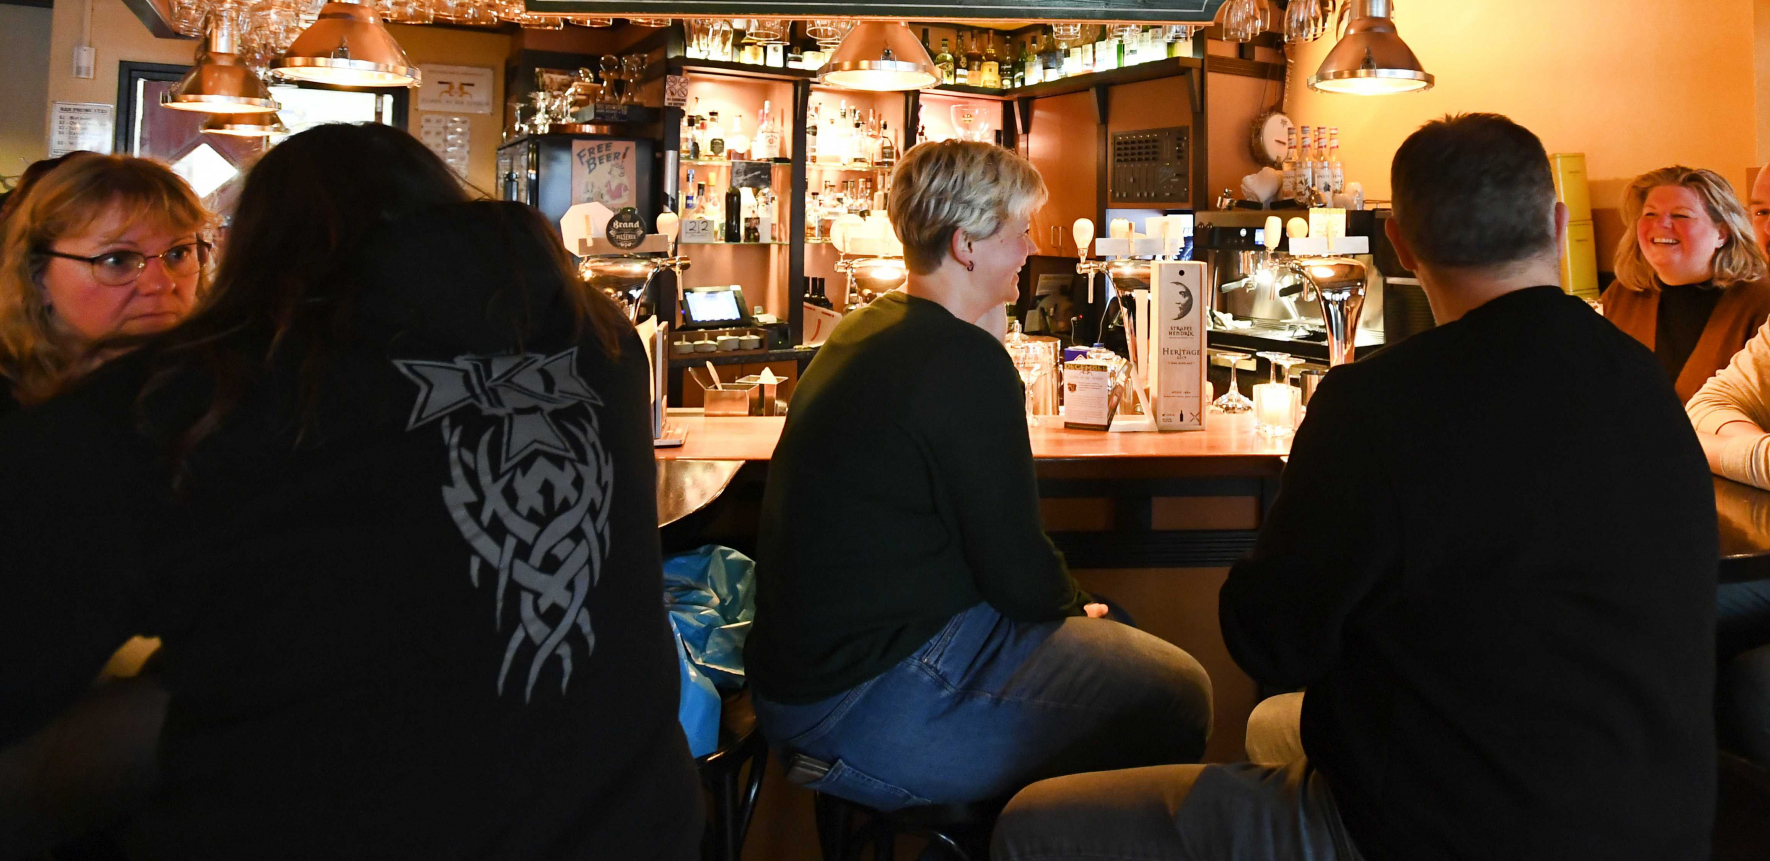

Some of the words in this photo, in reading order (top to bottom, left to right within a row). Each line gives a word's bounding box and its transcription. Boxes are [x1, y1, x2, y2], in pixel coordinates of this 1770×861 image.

[576, 142, 613, 166] FREE
[586, 146, 630, 174] BEER!
[613, 220, 640, 229] Brand
